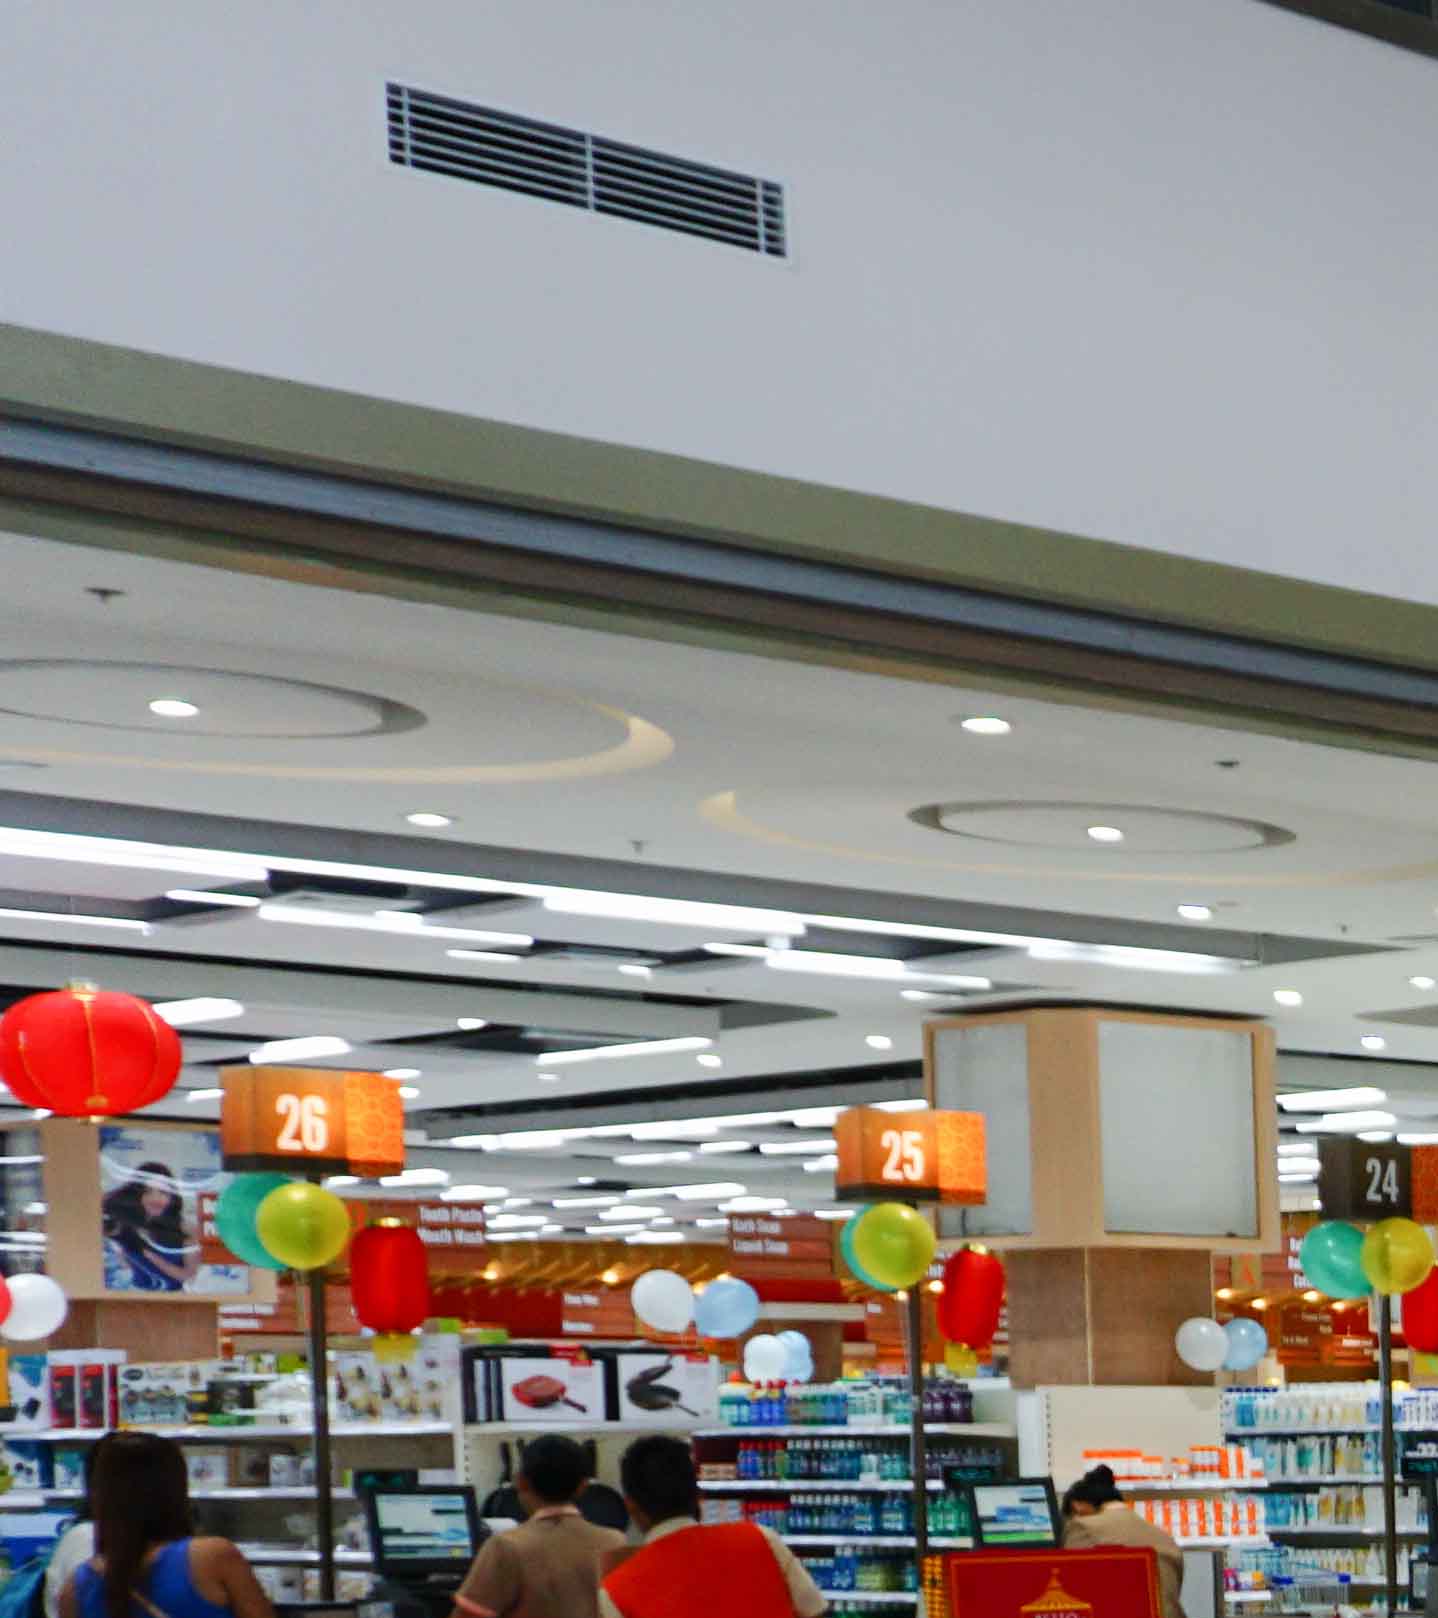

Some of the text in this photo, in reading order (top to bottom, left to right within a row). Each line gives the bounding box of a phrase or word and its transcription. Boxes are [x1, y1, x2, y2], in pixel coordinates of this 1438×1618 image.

[275, 1093, 329, 1152] 26
[880, 1131, 925, 1181] 25
[1365, 1157, 1400, 1202] 24
